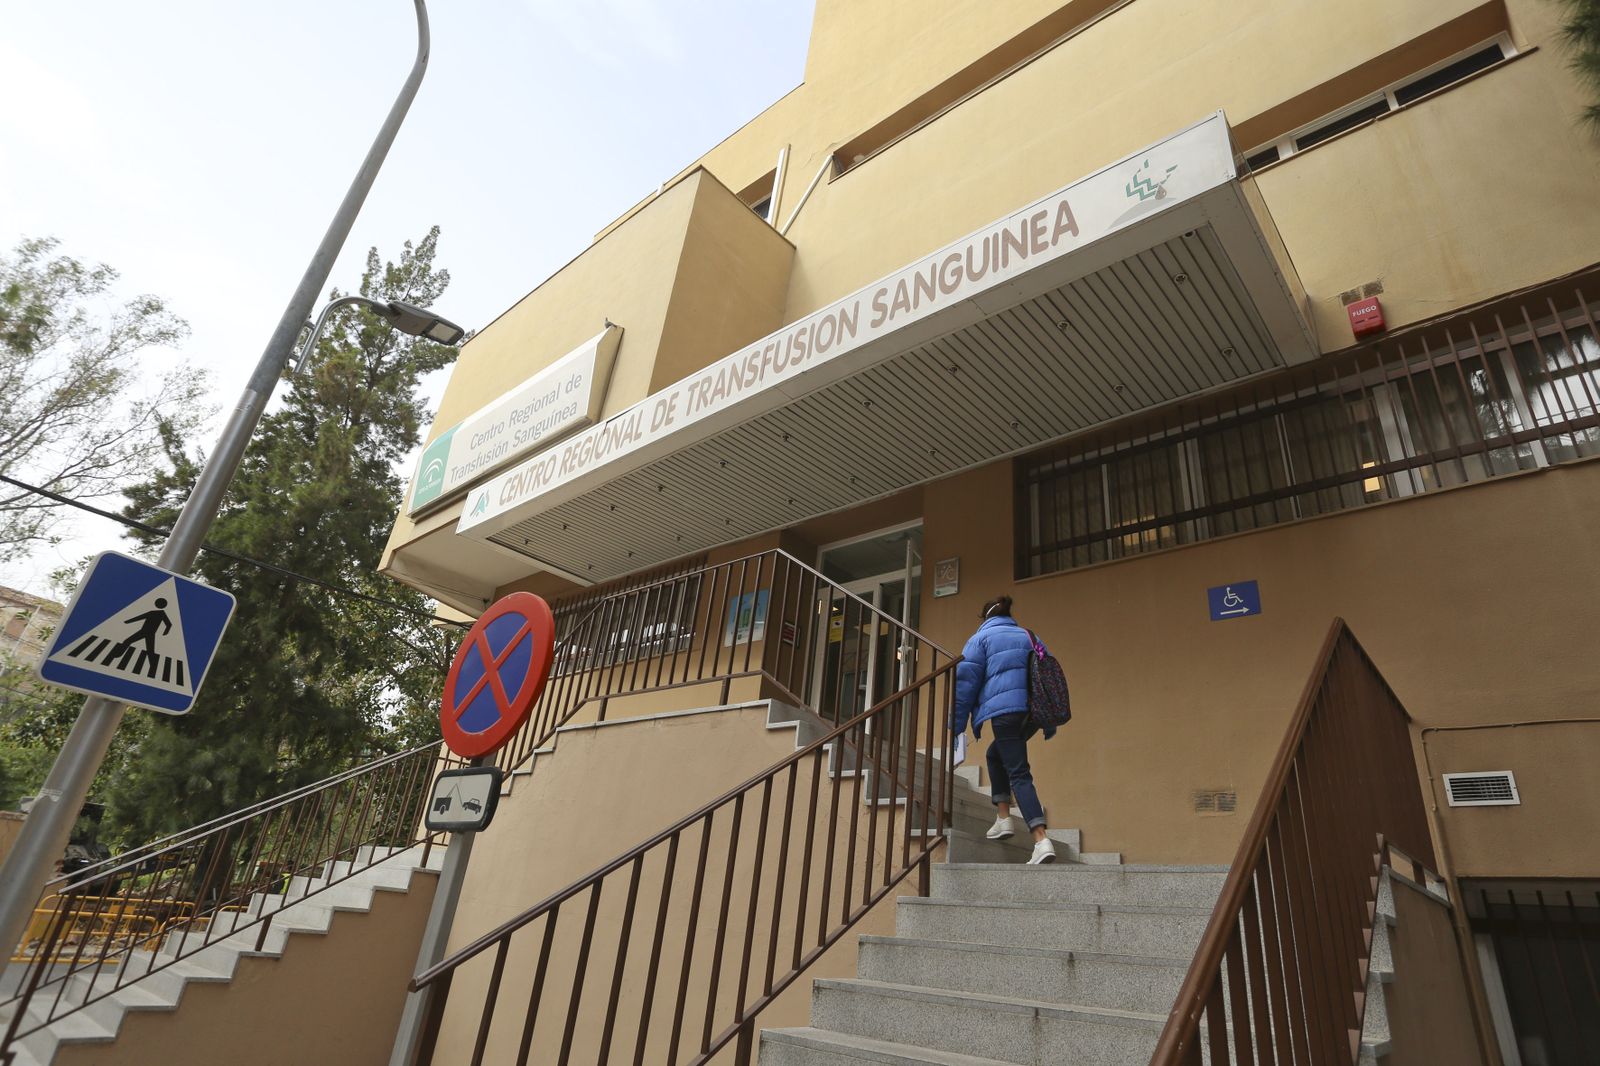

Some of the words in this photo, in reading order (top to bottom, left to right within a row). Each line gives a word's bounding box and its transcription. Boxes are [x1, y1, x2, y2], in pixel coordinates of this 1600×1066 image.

[1352, 305, 1377, 317] FUEGO
[499, 454, 557, 506] CENTRO
[558, 409, 644, 478] REGIONAL
[650, 391, 680, 433] DE
[686, 300, 860, 416] TRANSFUSION
[870, 200, 1080, 329] SANGUINEA
[450, 440, 509, 483] Transfusión
[512, 401, 578, 448] Sanguínea
[470, 420, 505, 450] Centro
[508, 382, 561, 427] Regional
[565, 374, 582, 394] de
